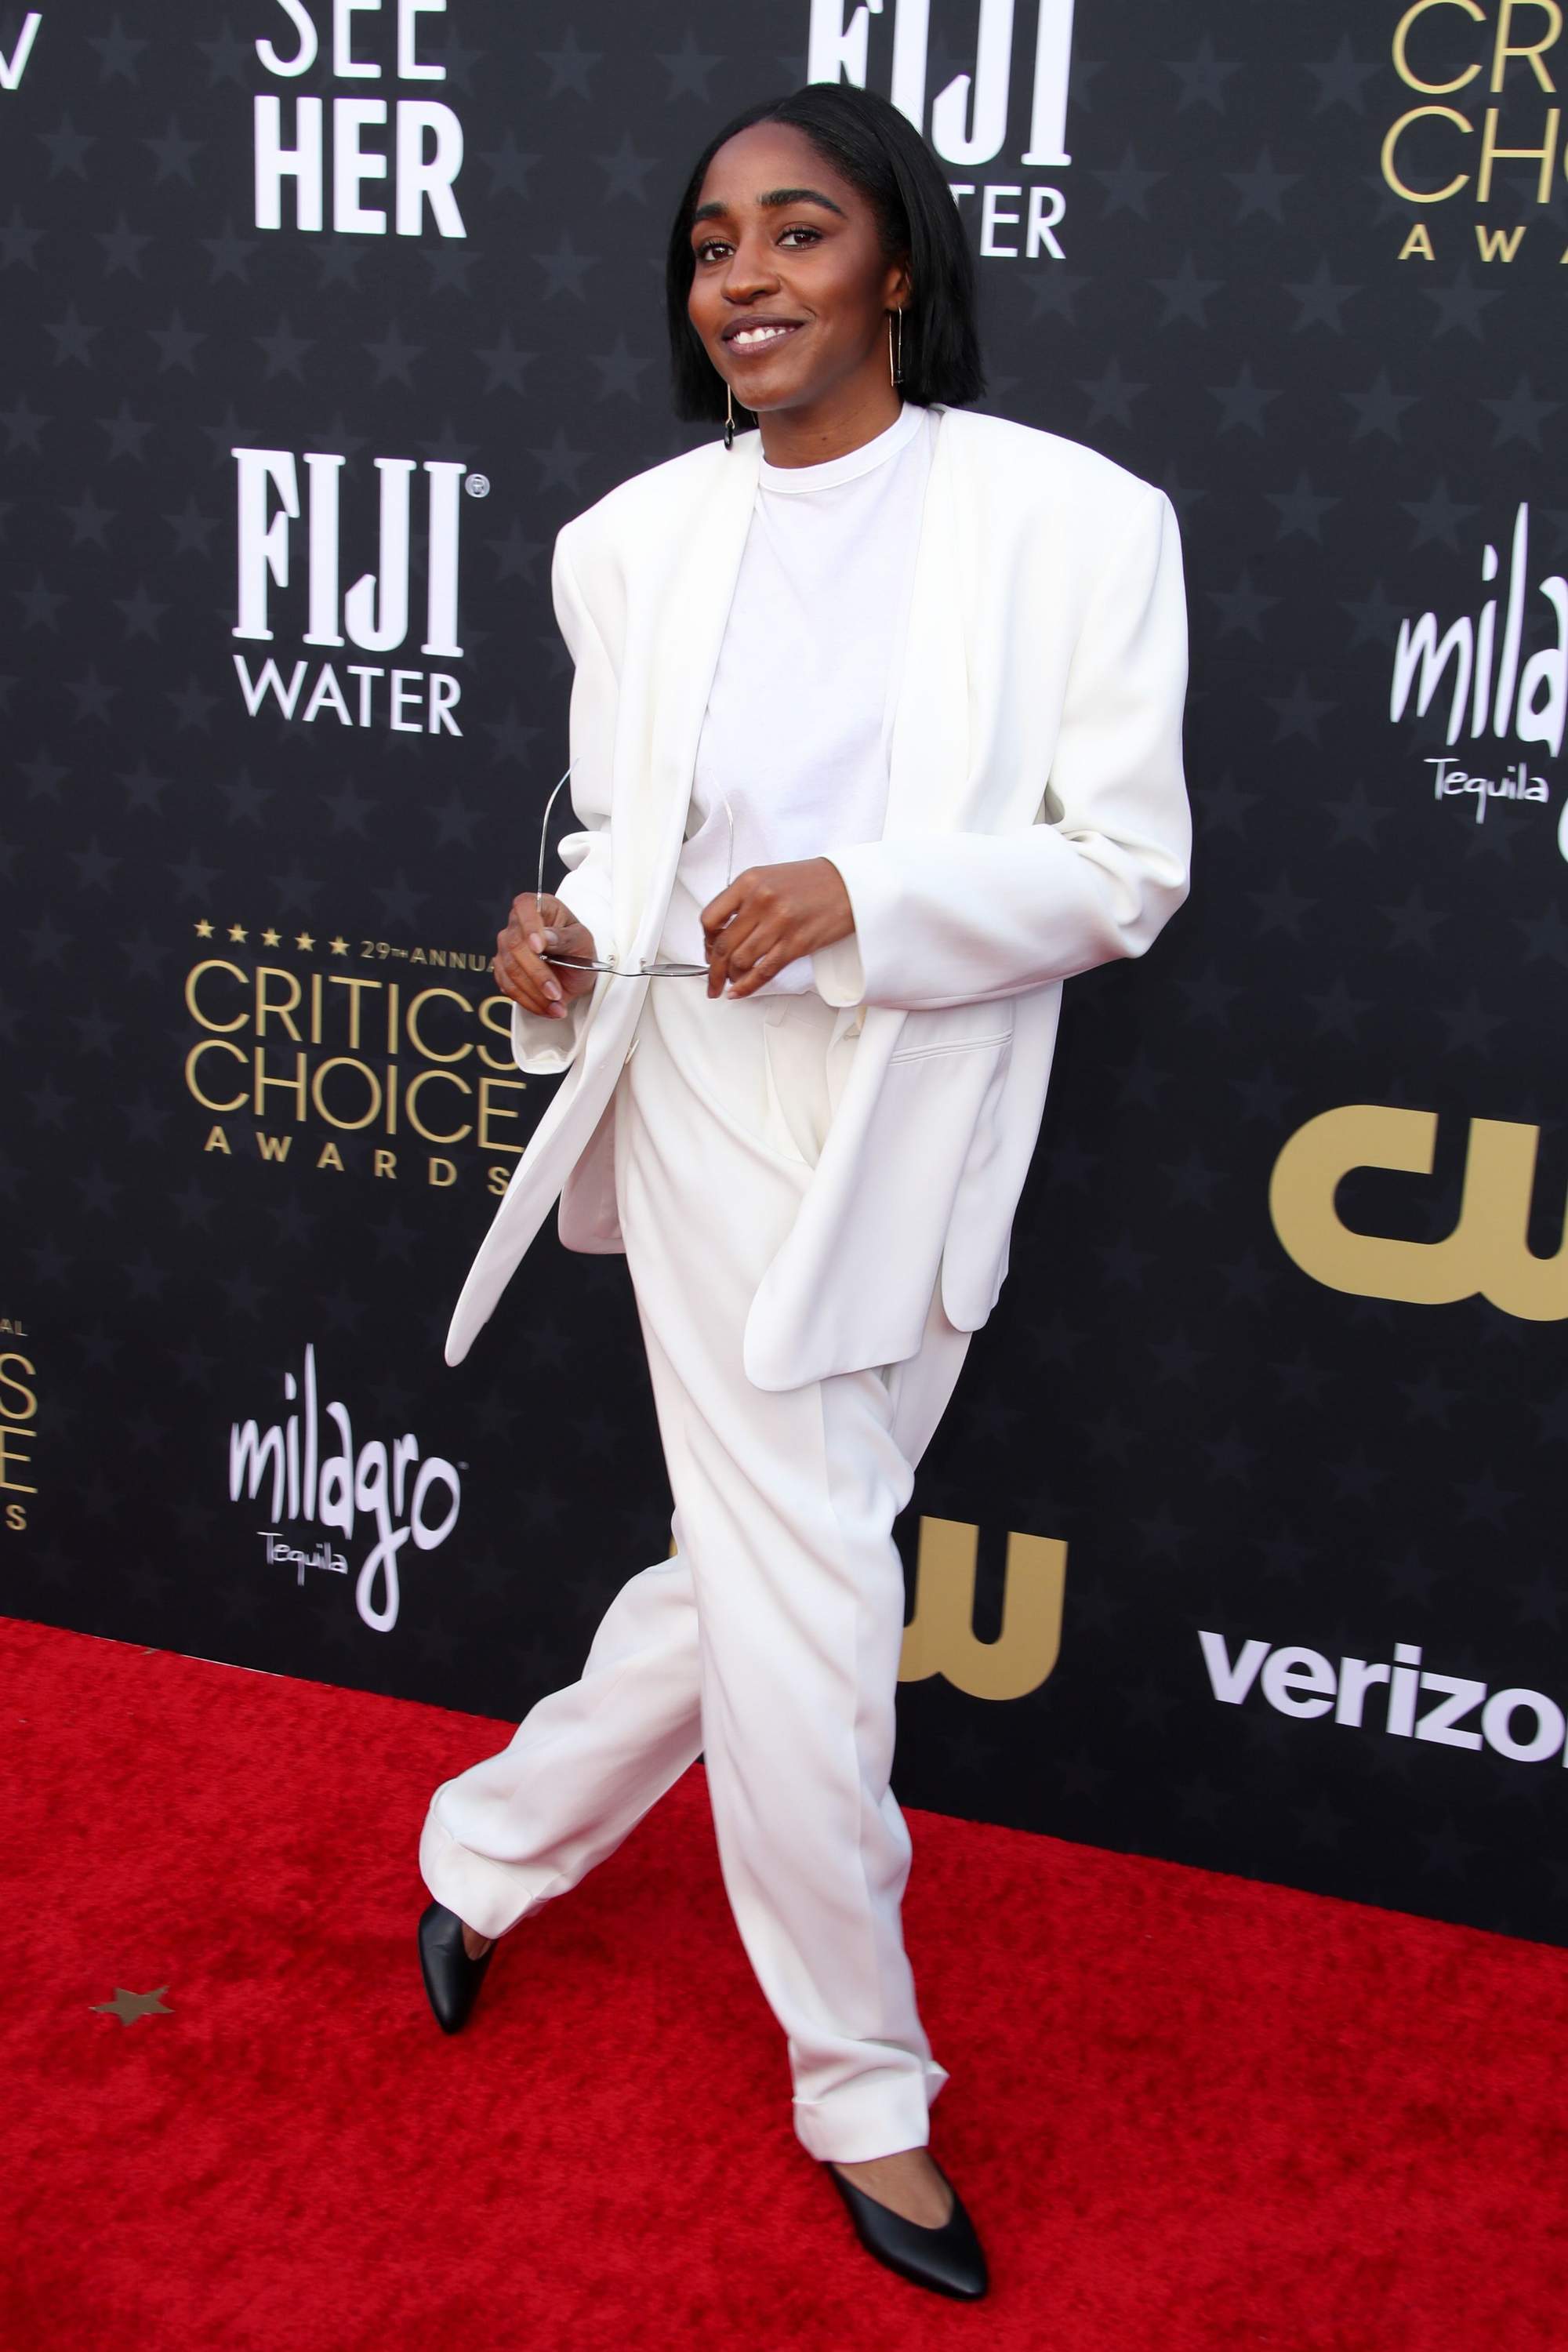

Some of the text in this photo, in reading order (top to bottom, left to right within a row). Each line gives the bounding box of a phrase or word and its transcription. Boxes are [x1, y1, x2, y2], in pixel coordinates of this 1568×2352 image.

[254, 95, 467, 238] HER
[233, 655, 463, 737] WATER
[1390, 502, 1568, 862] mila
[1424, 758, 1549, 824] Tequila
[409, 947, 495, 972] ANNU
[185, 960, 519, 1071] CRITICS
[185, 1040, 526, 1153] CHOICE
[204, 1126, 510, 1196] AWARDS
[230, 1343, 461, 1632] milagro
[256, 1531, 348, 1586] Tequila
[1197, 1630, 1568, 1769] verizo
